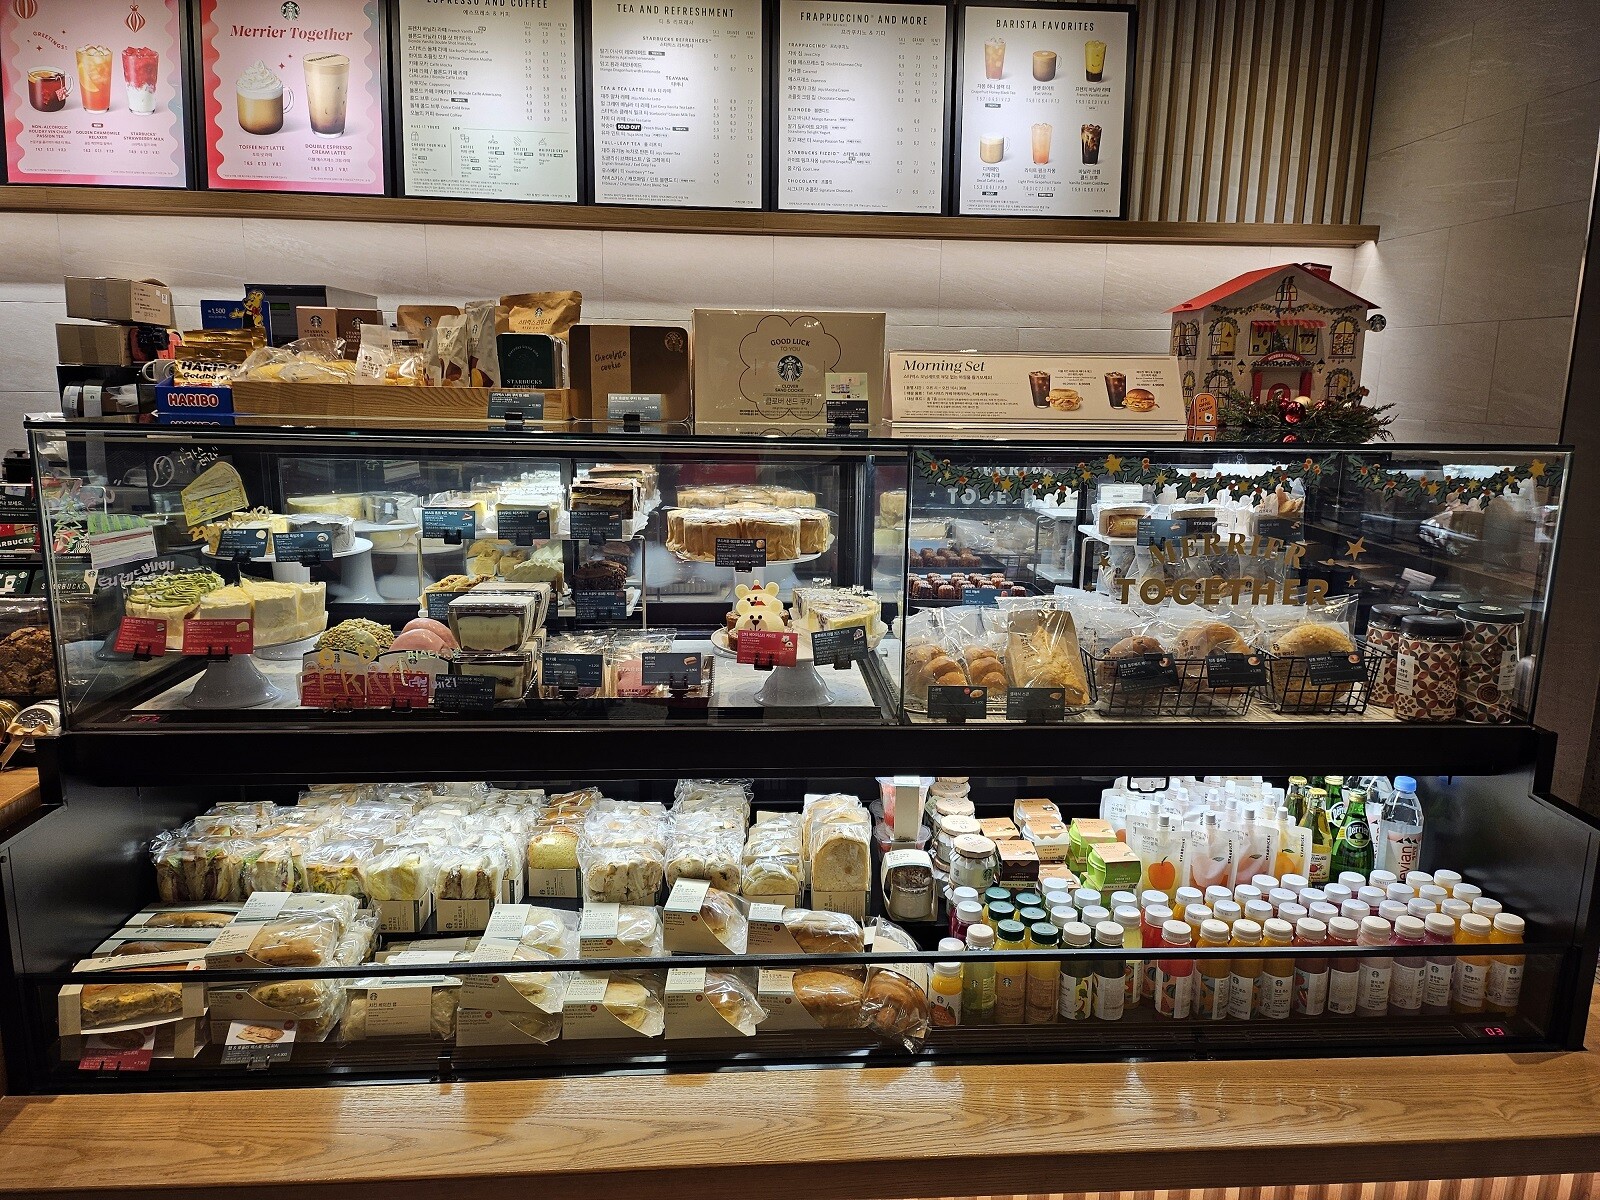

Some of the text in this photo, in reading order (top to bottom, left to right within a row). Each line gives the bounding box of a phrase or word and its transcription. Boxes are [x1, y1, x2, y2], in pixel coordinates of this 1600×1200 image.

[616, 4, 734, 17] TEA AND REFRESHMENT
[878, 15, 897, 24] AND
[902, 16, 927, 25] MORE
[996, 20, 1094, 31] BARISTA FAVORITES
[230, 24, 353, 43] Merrier Together
[770, 338, 810, 347] GOOD LUCK
[595, 350, 627, 362] Chocolate
[600, 361, 621, 372] cookie
[902, 360, 985, 373] Morning Set
[168, 393, 219, 407] HARIBO
[800, 397, 813, 406] 쿠키
[1148, 532, 1308, 570] MERRIER
[1117, 578, 1330, 606] TOGETHER
[1347, 825, 1370, 834] Perrier
[1399, 845, 1413, 882] evian
[1484, 1027, 1505, 1037] 03
